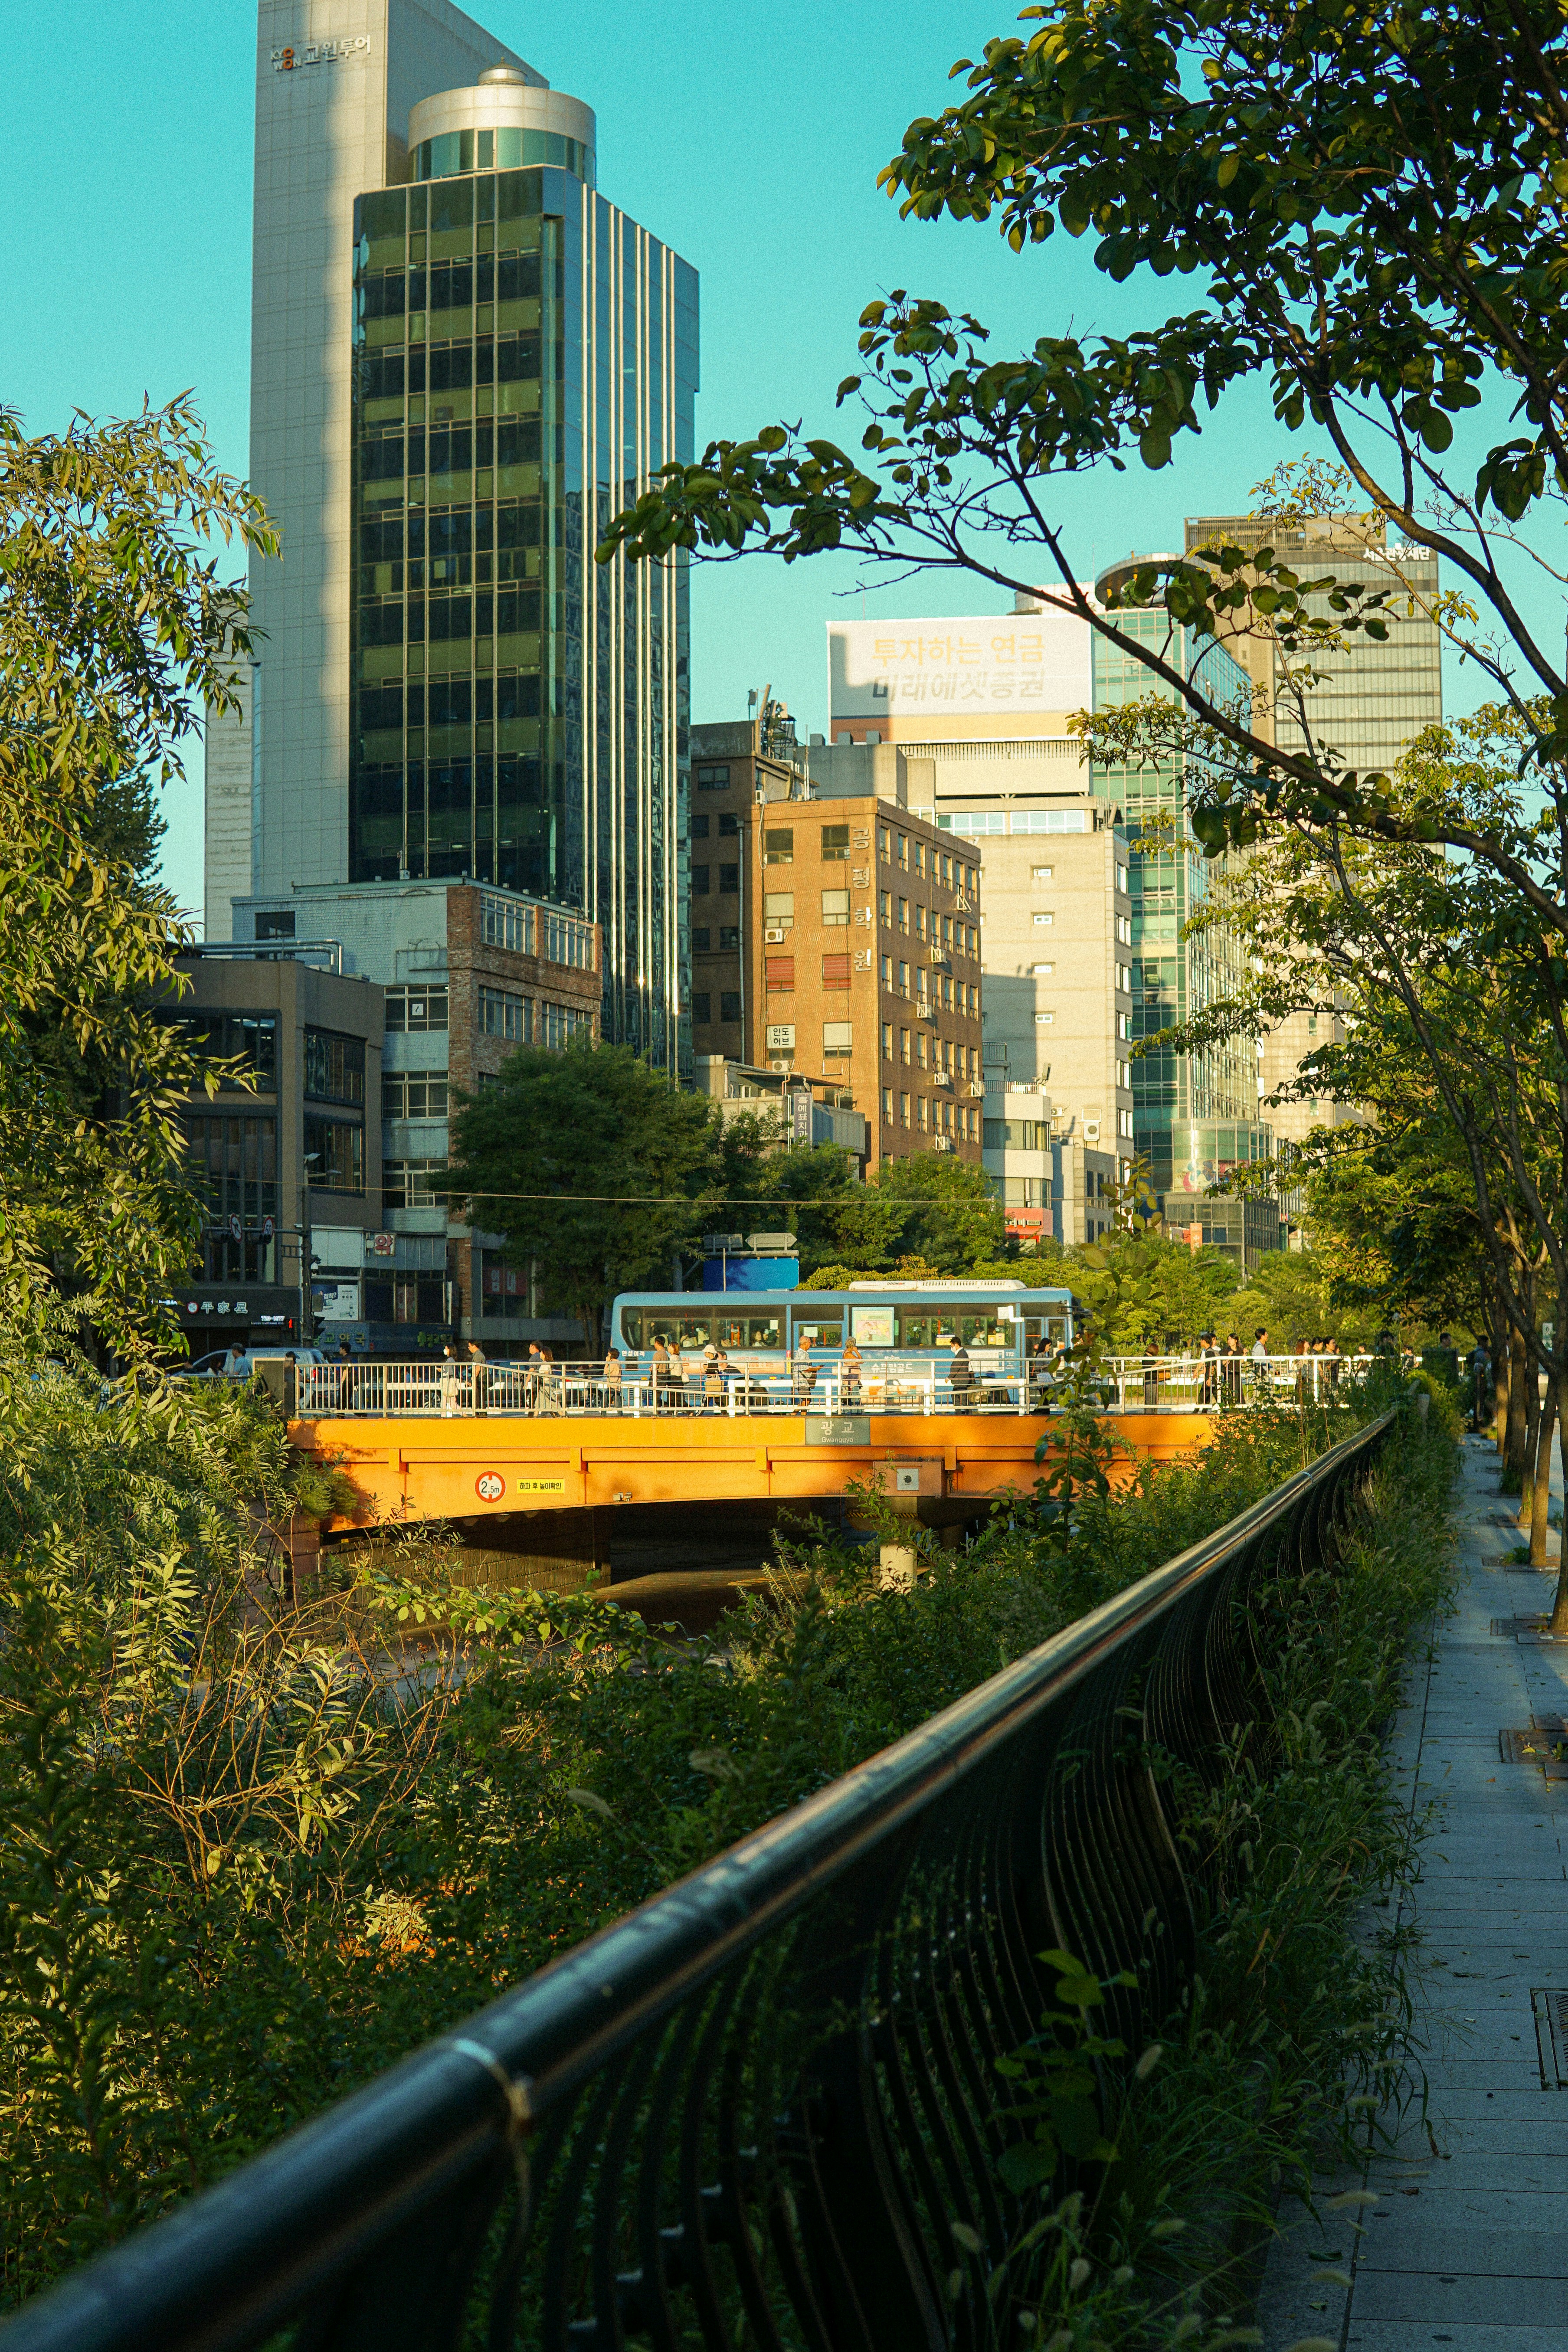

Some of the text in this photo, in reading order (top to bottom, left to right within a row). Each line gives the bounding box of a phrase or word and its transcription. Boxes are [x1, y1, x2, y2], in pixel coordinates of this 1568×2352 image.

[304, 34, 370, 64] 교원투어
[274, 58, 302, 71] WON
[1363, 542, 1431, 561] 서울관광재단
[872, 633, 1045, 667] 투자하는 연금
[872, 668, 1046, 702] 미래에셋증권
[848, 828, 873, 972] 공평학원
[773, 1027, 789, 1036] 인도
[773, 1037, 789, 1046] 허브
[375, 1235, 393, 1256] 약
[491, 1269, 516, 1293] 임대
[200, 1301, 248, 1314] 平家屋
[871, 1363, 914, 1374] 슈프림골드
[821, 1436, 854, 1444] Gwanggyo
[481, 1481, 500, 1493] 2.5m
[540, 1482, 562, 1490] 높이확인
